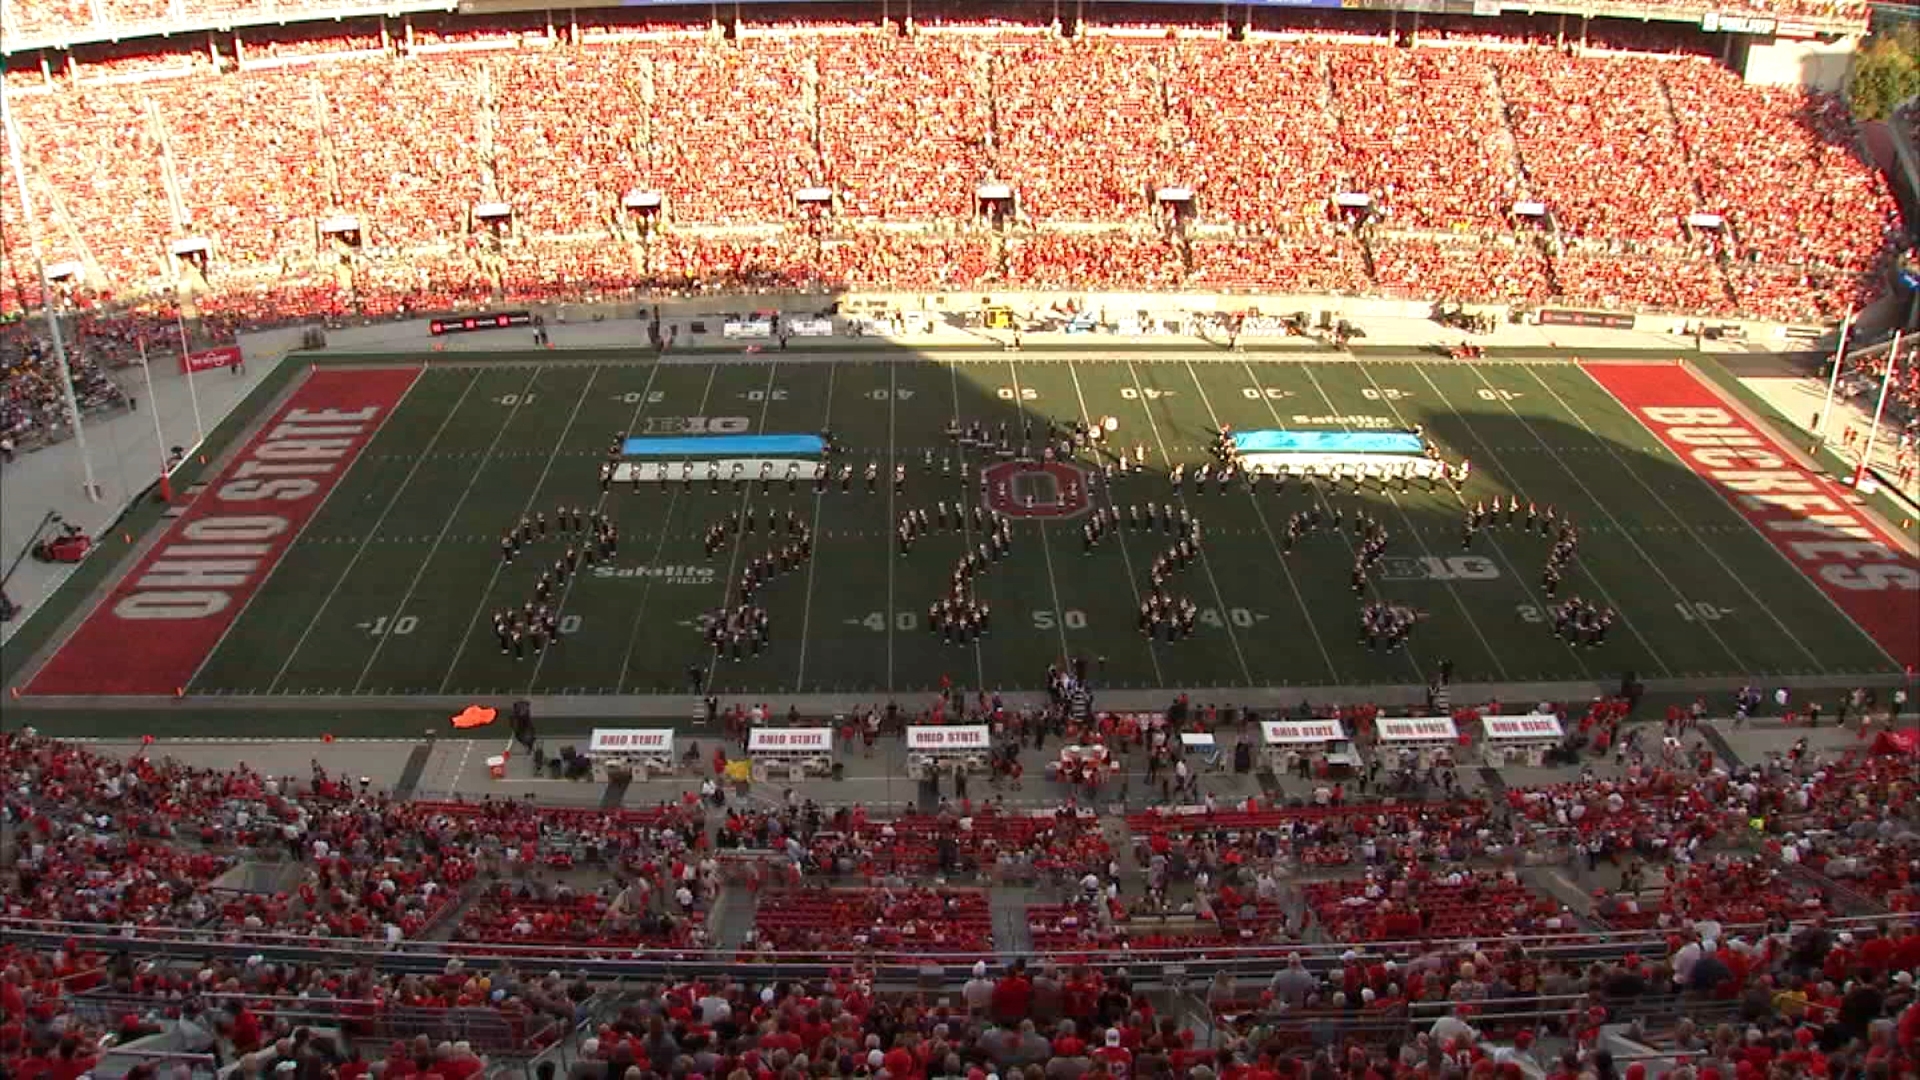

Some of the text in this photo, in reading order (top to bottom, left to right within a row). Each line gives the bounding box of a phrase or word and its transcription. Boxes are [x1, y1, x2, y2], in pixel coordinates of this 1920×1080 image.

[1641, 407, 1920, 590] BUCKEYES
[112, 406, 382, 619] OHIO STATE
[1032, 610, 1088, 630] 50
[1200, 608, 1255, 628] 40
[1675, 602, 1722, 620] 10
[371, 616, 419, 634] 10
[863, 612, 917, 631] 40
[601, 735, 663, 745] OHIO STATE
[758, 735, 822, 744] OHIO STATE
[916, 732, 981, 742] OHIO STATE
